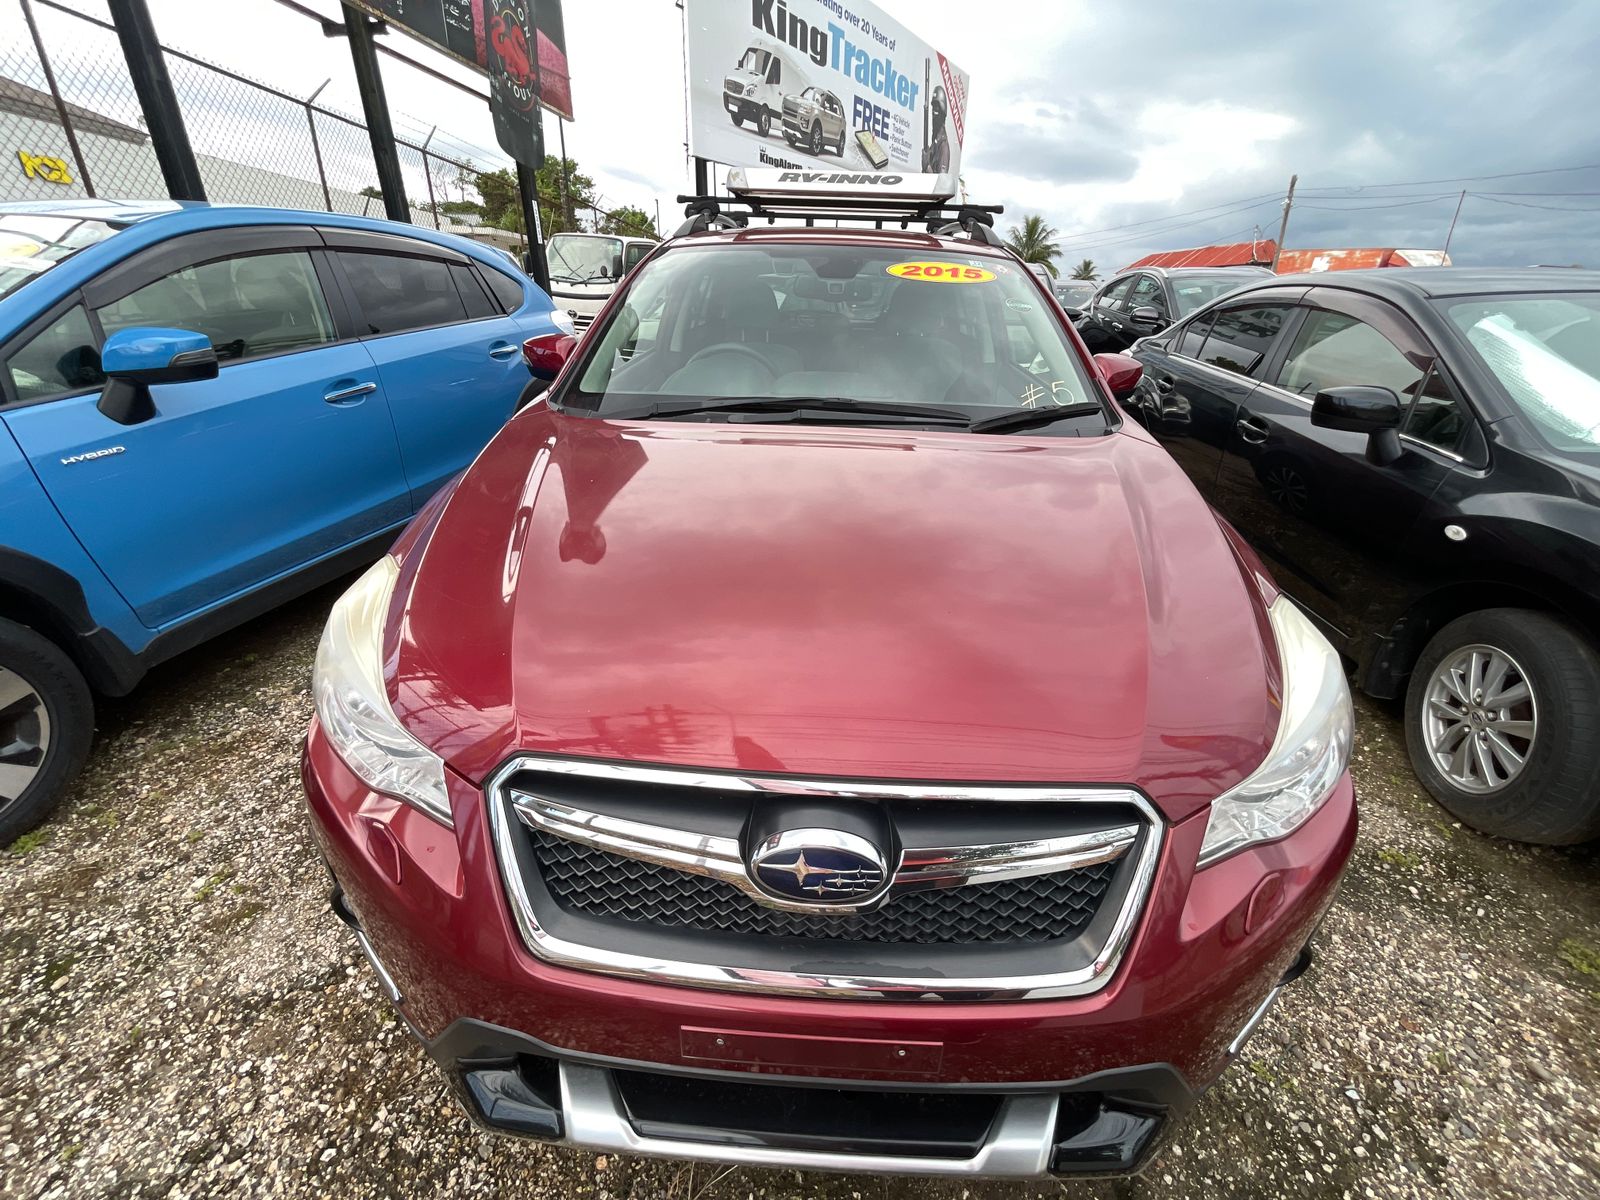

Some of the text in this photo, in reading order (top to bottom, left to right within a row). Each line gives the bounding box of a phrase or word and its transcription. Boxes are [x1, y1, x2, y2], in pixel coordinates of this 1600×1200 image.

[844, 9, 860, 27] over
[861, 18, 870, 34] 20
[871, 26, 888, 47] Years
[889, 39, 896, 52] of
[853, 94, 890, 141] FREE
[759, 152, 803, 169] KingAlarm
[778, 172, 903, 185] RV-INNO
[901, 265, 983, 279] 2015
[60, 446, 126, 465] HYBRID
